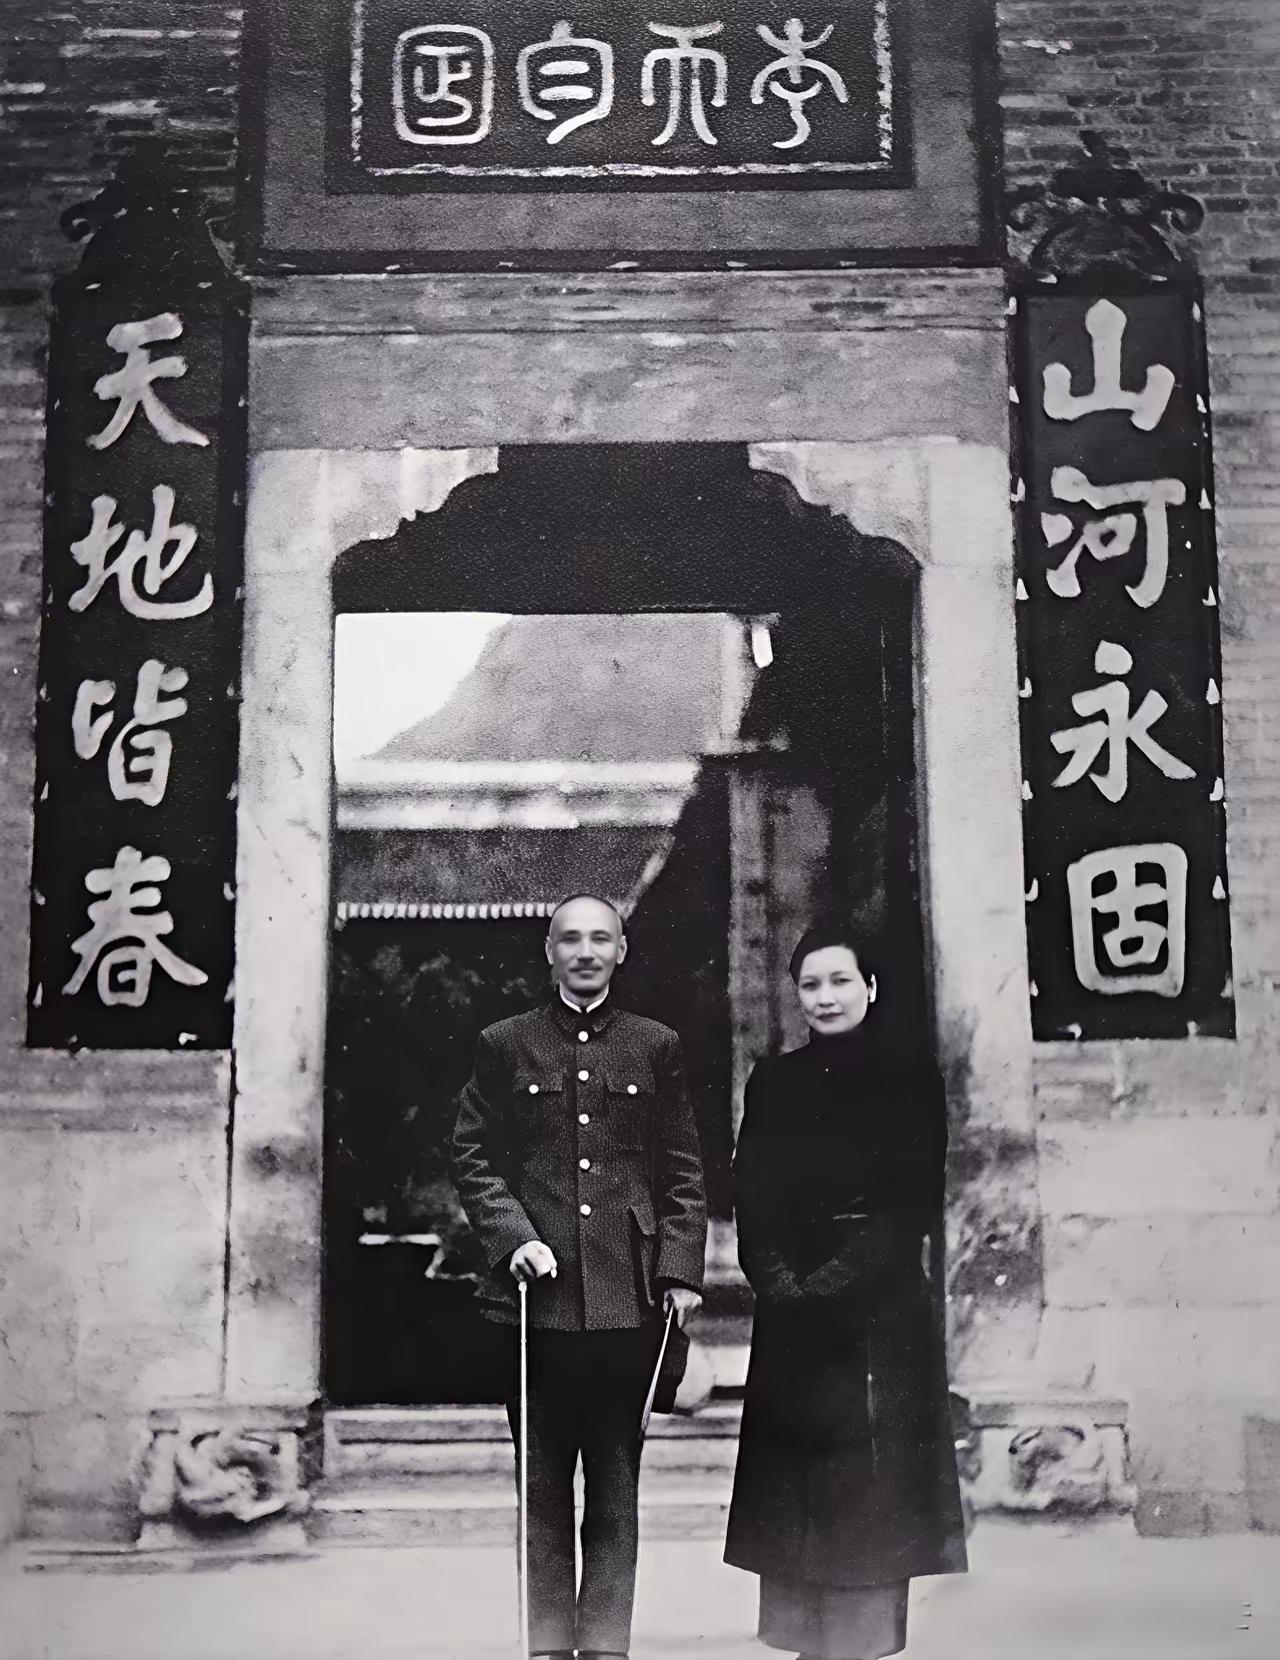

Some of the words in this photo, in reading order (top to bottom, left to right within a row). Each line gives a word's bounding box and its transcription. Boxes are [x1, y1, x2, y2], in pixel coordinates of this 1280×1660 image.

[63, 312, 215, 1007] 天地皆春
[1040, 298, 1197, 998] 山河永固
